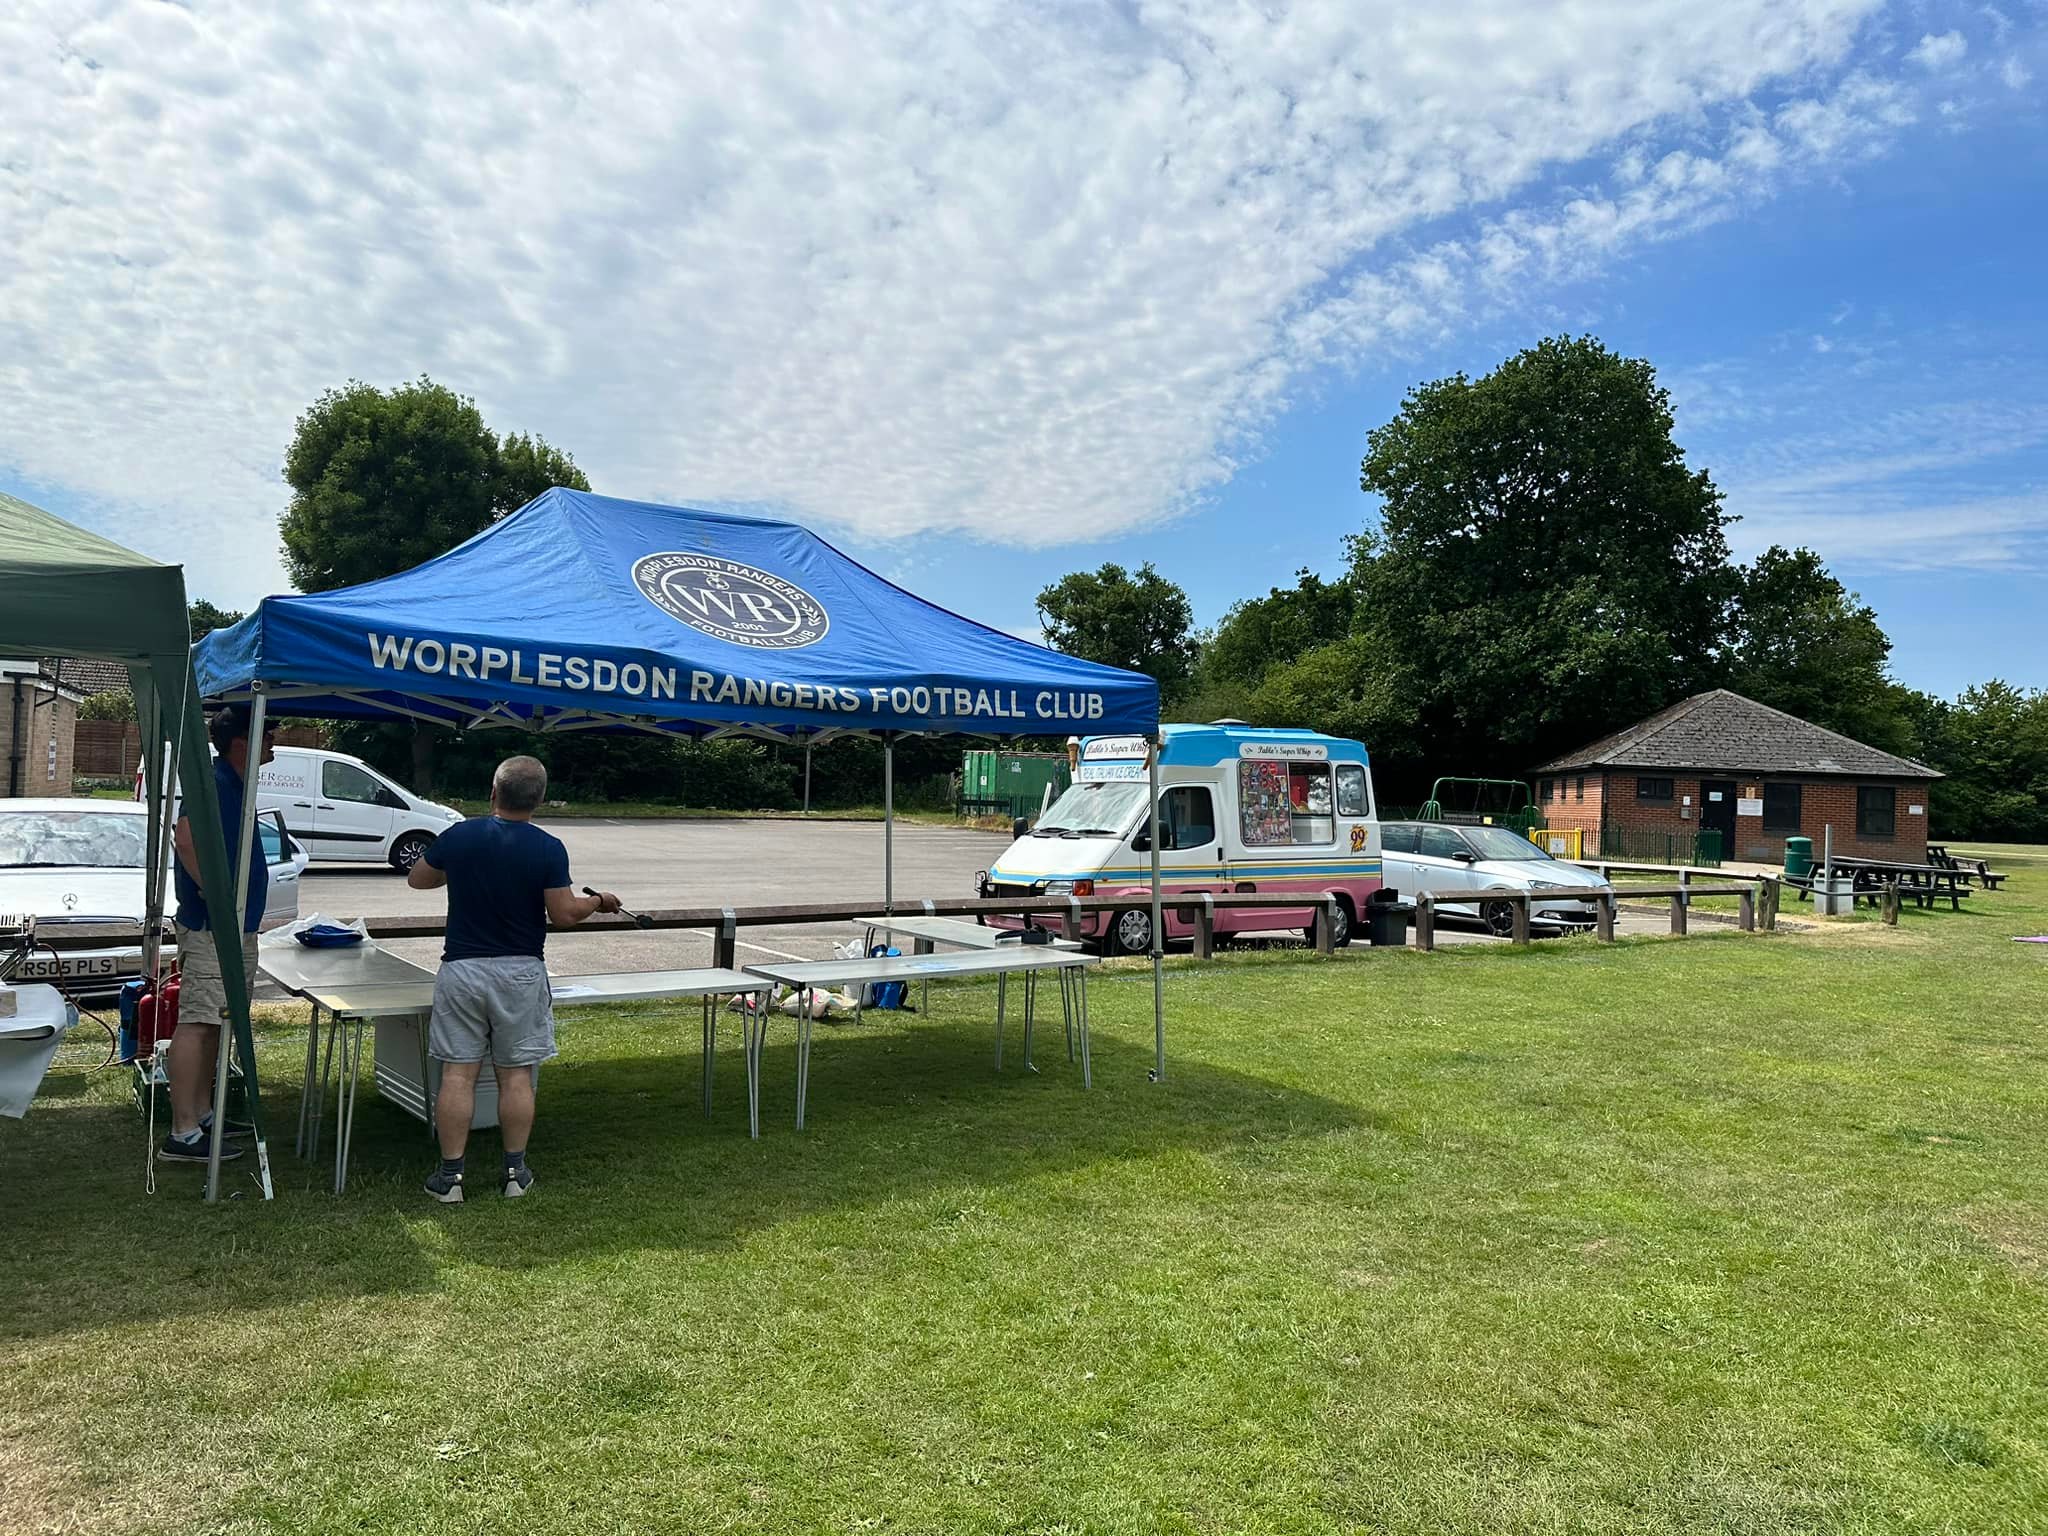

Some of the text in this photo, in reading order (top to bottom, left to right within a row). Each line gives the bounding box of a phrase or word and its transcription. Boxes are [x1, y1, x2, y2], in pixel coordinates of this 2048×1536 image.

[639, 555, 805, 602] WORPLESDON RANGERS
[690, 619, 816, 647] FOOTBALL CLUB
[731, 621, 768, 632] 2001
[368, 633, 1105, 720] WORPLESDON RANGERS FOOTBALL CLUB
[1109, 743, 1128, 755] Super
[1279, 746, 1296, 757] Super
[1296, 746, 1312, 757] Whip
[1350, 828, 1365, 845] 99
[24, 959, 112, 975] RS05 PLS
